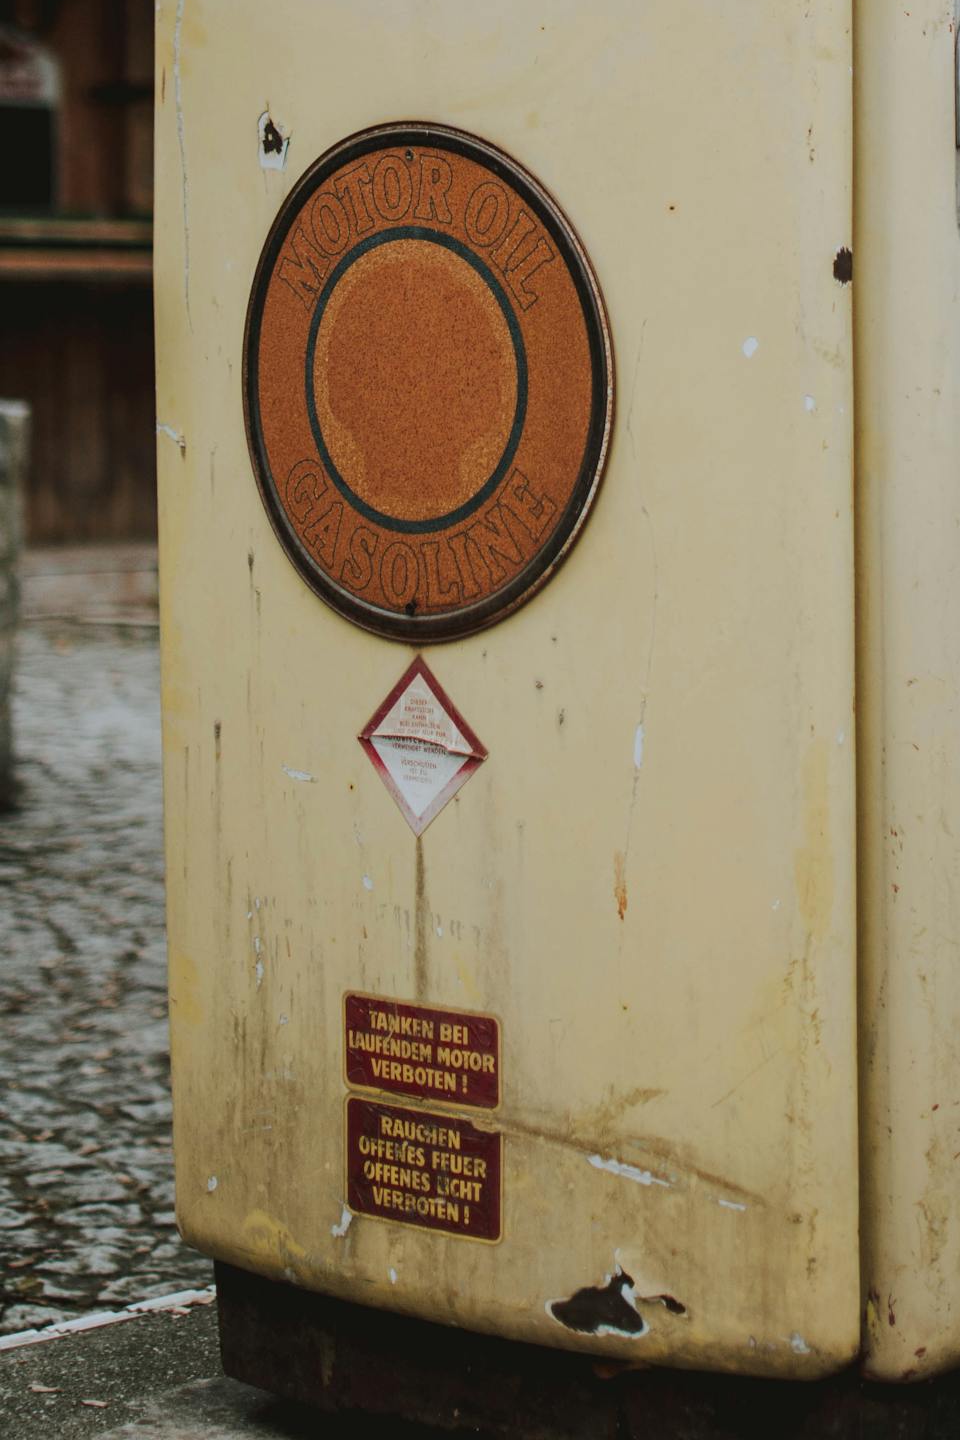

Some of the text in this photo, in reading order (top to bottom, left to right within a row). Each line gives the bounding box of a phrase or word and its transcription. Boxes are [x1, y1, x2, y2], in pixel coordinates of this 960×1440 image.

[276, 154, 556, 312] MOTOR OIL
[286, 459, 557, 608] GASOLINE
[369, 1010, 469, 1045] TANKEN BEI
[348, 1030, 495, 1074] LAUFENDEM MOTOR
[371, 1057, 457, 1092] VERBOTEN
[380, 1115, 461, 1150] RAUCHEN
[358, 1135, 487, 1179] OFFENES FEUER
[363, 1160, 482, 1203] OFFENES LICHT
[372, 1185, 459, 1222] VERBOTEN
